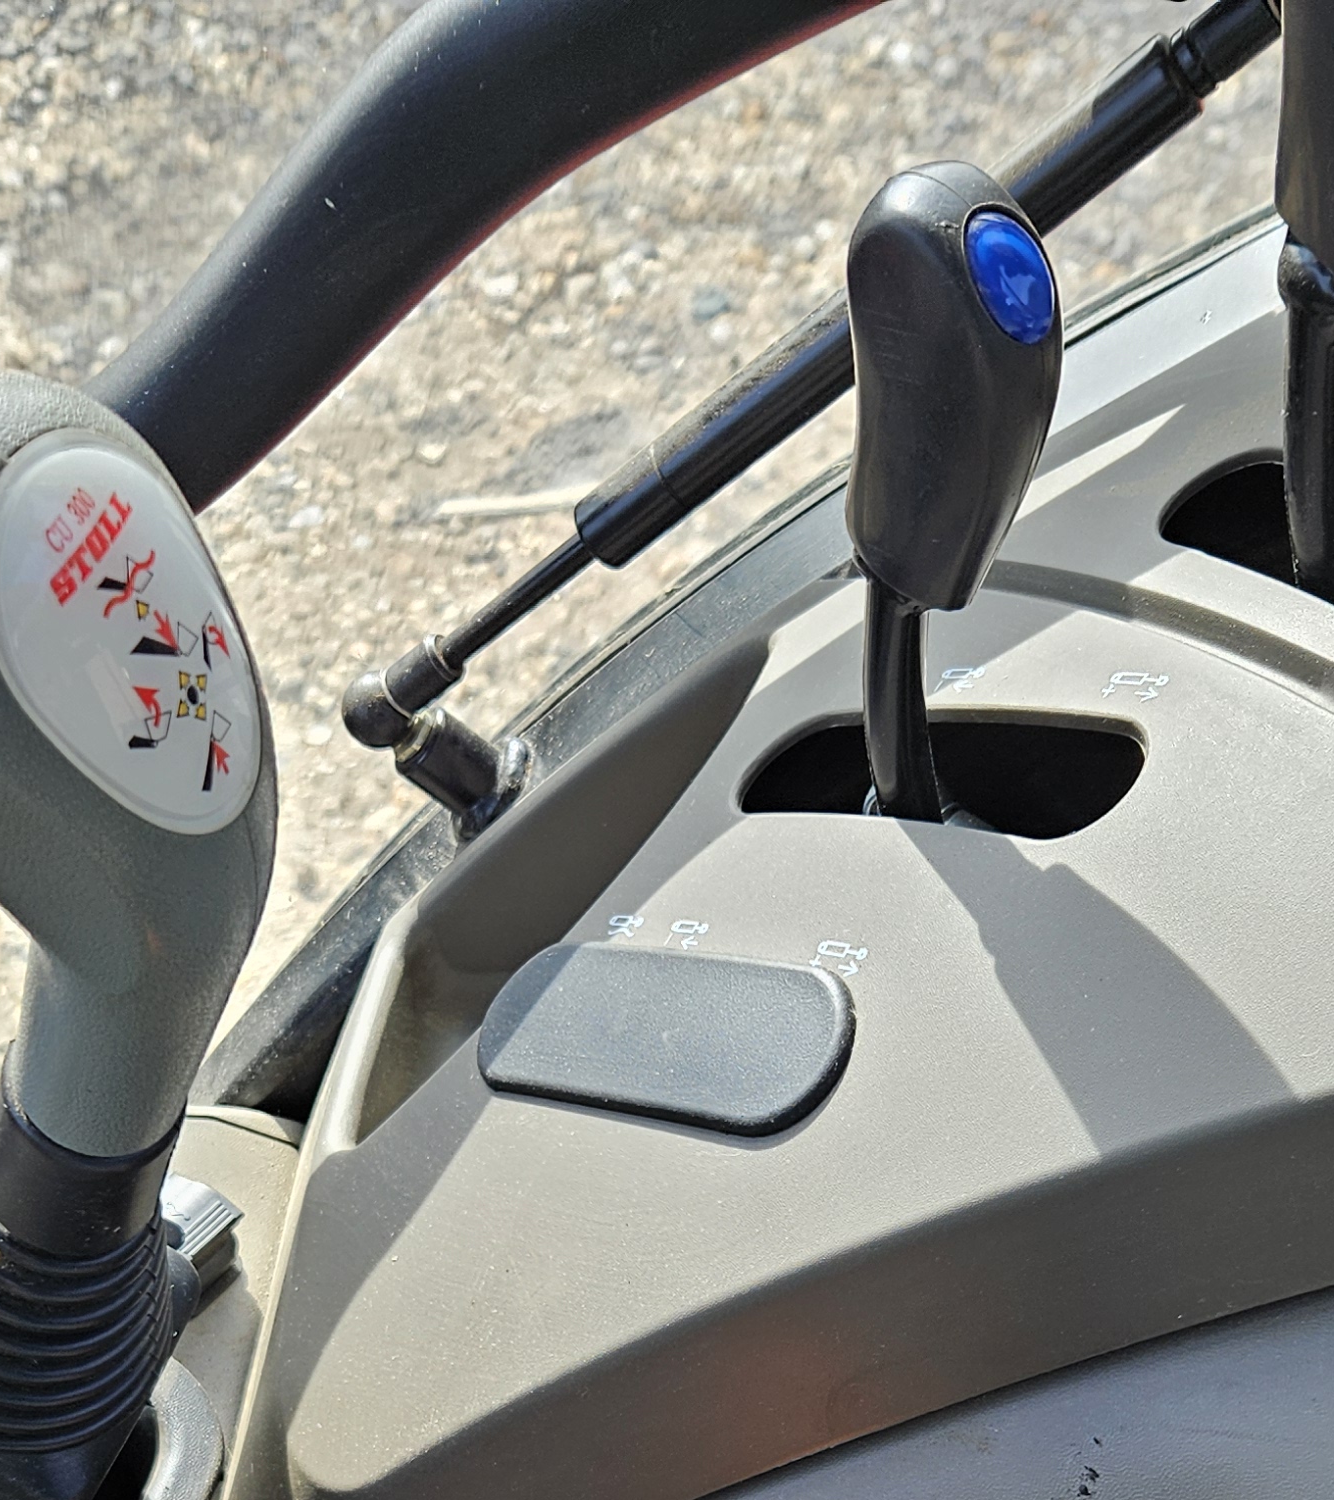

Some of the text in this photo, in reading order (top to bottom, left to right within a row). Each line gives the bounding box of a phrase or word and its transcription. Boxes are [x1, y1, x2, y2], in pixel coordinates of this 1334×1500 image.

[45, 487, 96, 553] CU 300
[50, 491, 133, 607] STOLL
